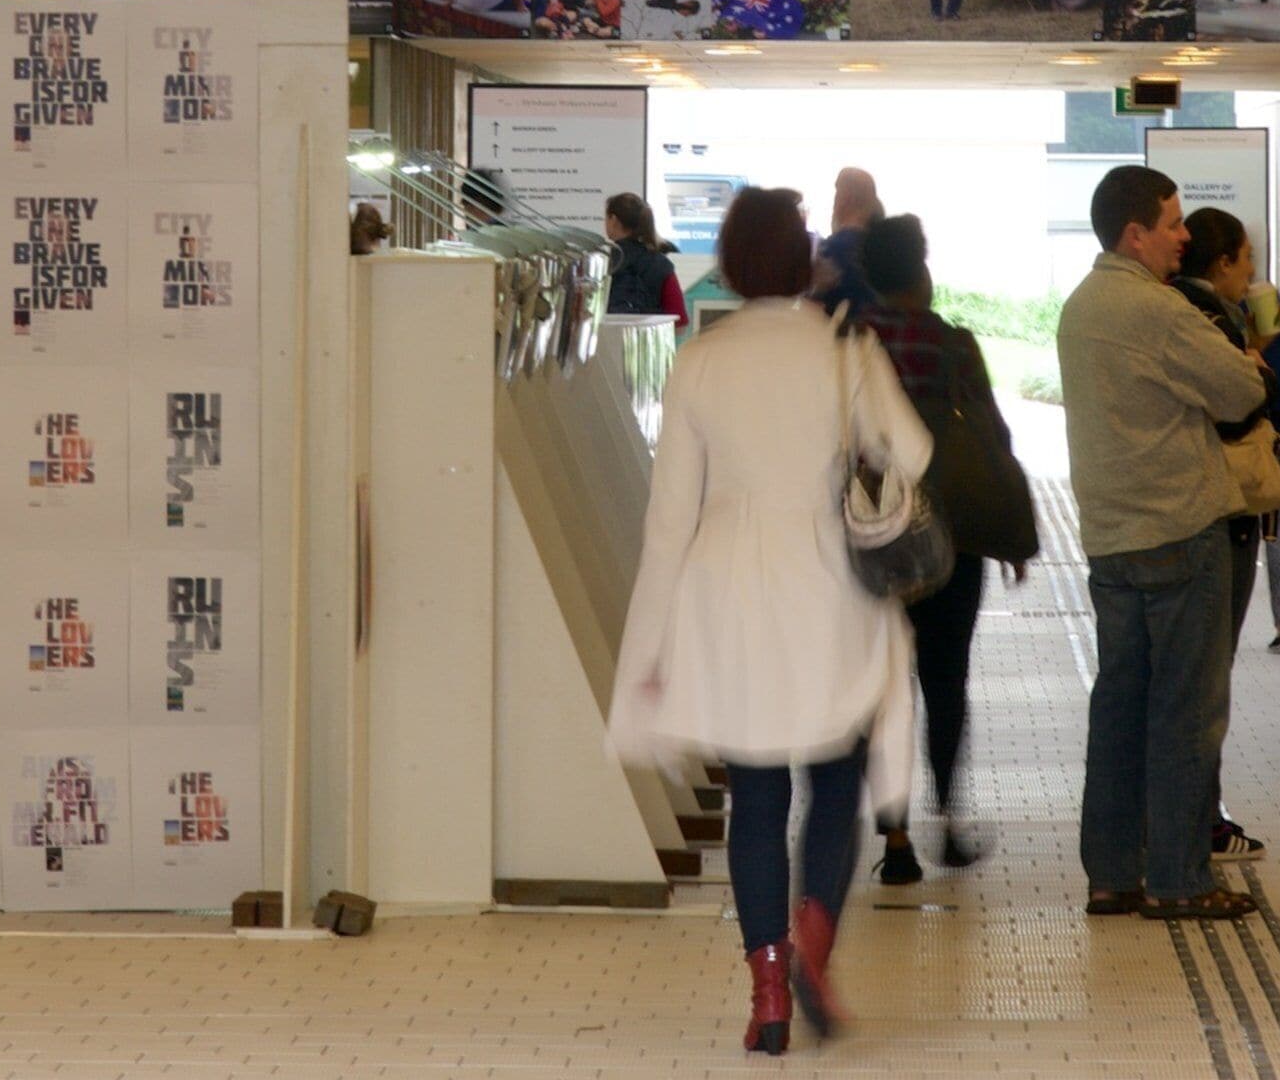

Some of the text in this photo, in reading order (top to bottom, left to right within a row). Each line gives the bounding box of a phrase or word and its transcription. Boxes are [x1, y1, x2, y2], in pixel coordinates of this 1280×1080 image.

[14, 13, 98, 35] EVERY
[29, 36, 81, 57] ONE
[154, 26, 213, 49] CITY
[14, 58, 101, 80] BRAVE
[14, 104, 94, 126] GIVEN
[14, 198, 98, 220] EVERY
[29, 221, 81, 242] ONE
[154, 212, 213, 235] CITY
[14, 243, 101, 265] BRAVE
[14, 288, 94, 310] GIVEN
[166, 393, 221, 429] RU
[34, 413, 79, 435] HE
[166, 430, 221, 466] IN
[46, 461, 96, 483] ERS
[167, 577, 222, 613] RU
[34, 598, 79, 620] HE
[167, 614, 222, 650] IN
[46, 645, 96, 667] ERS
[169, 772, 213, 794] HE
[181, 820, 229, 841] ERS
